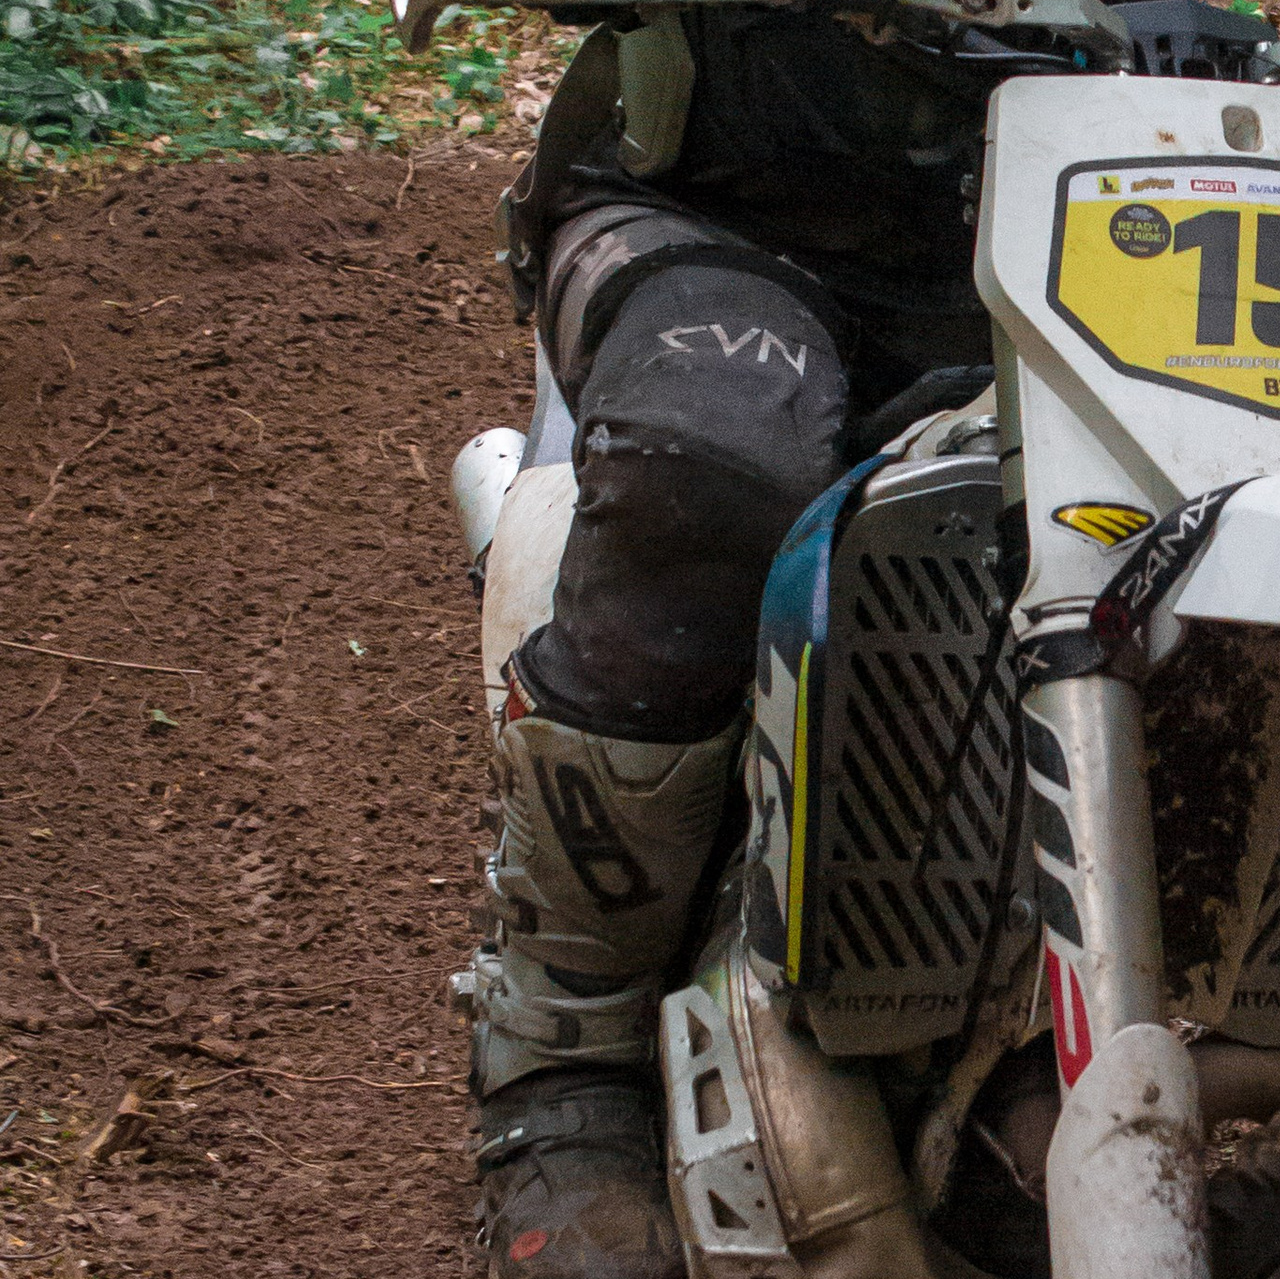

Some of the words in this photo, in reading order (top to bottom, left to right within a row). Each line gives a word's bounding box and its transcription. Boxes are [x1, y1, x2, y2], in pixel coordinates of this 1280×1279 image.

[1193, 180, 1236, 193] MOTUL
[1117, 221, 1161, 233] READY
[1113, 230, 1131, 242] TO
